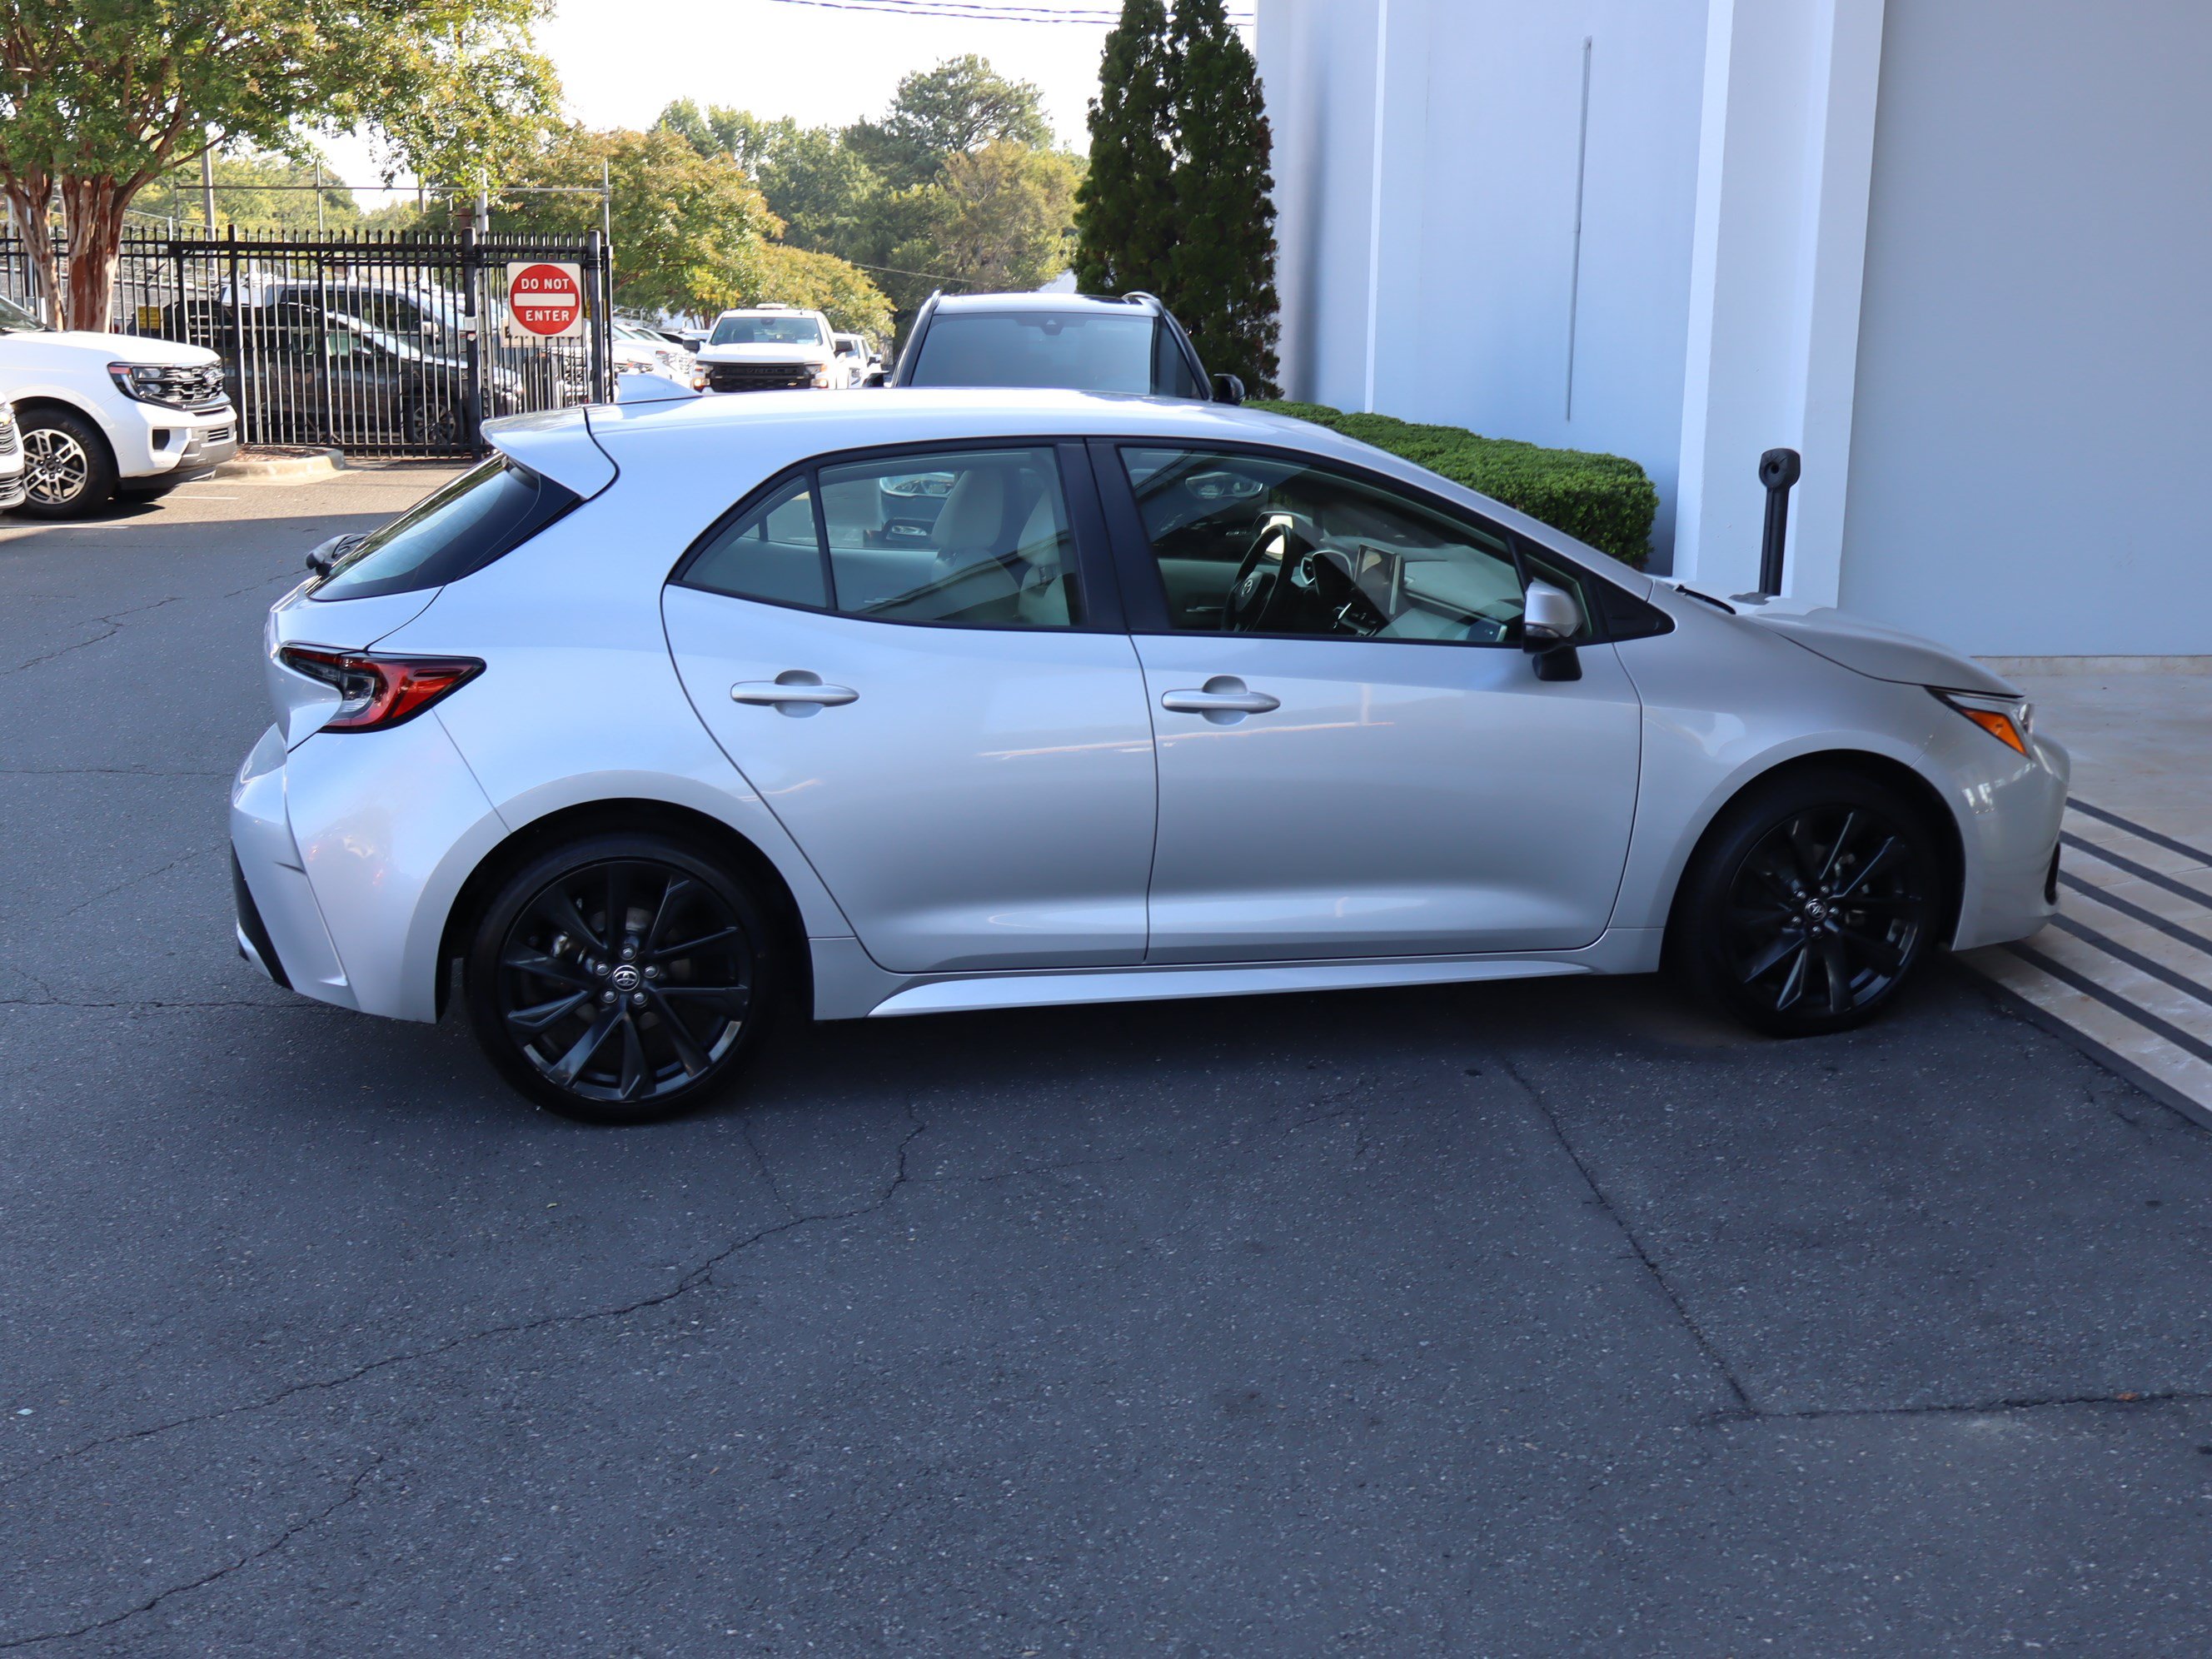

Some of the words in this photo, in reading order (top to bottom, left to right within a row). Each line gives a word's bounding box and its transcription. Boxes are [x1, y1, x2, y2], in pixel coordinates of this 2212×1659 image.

[521, 278, 539, 290] DO
[544, 278, 570, 290] NOT
[526, 310, 570, 321] ENTER
